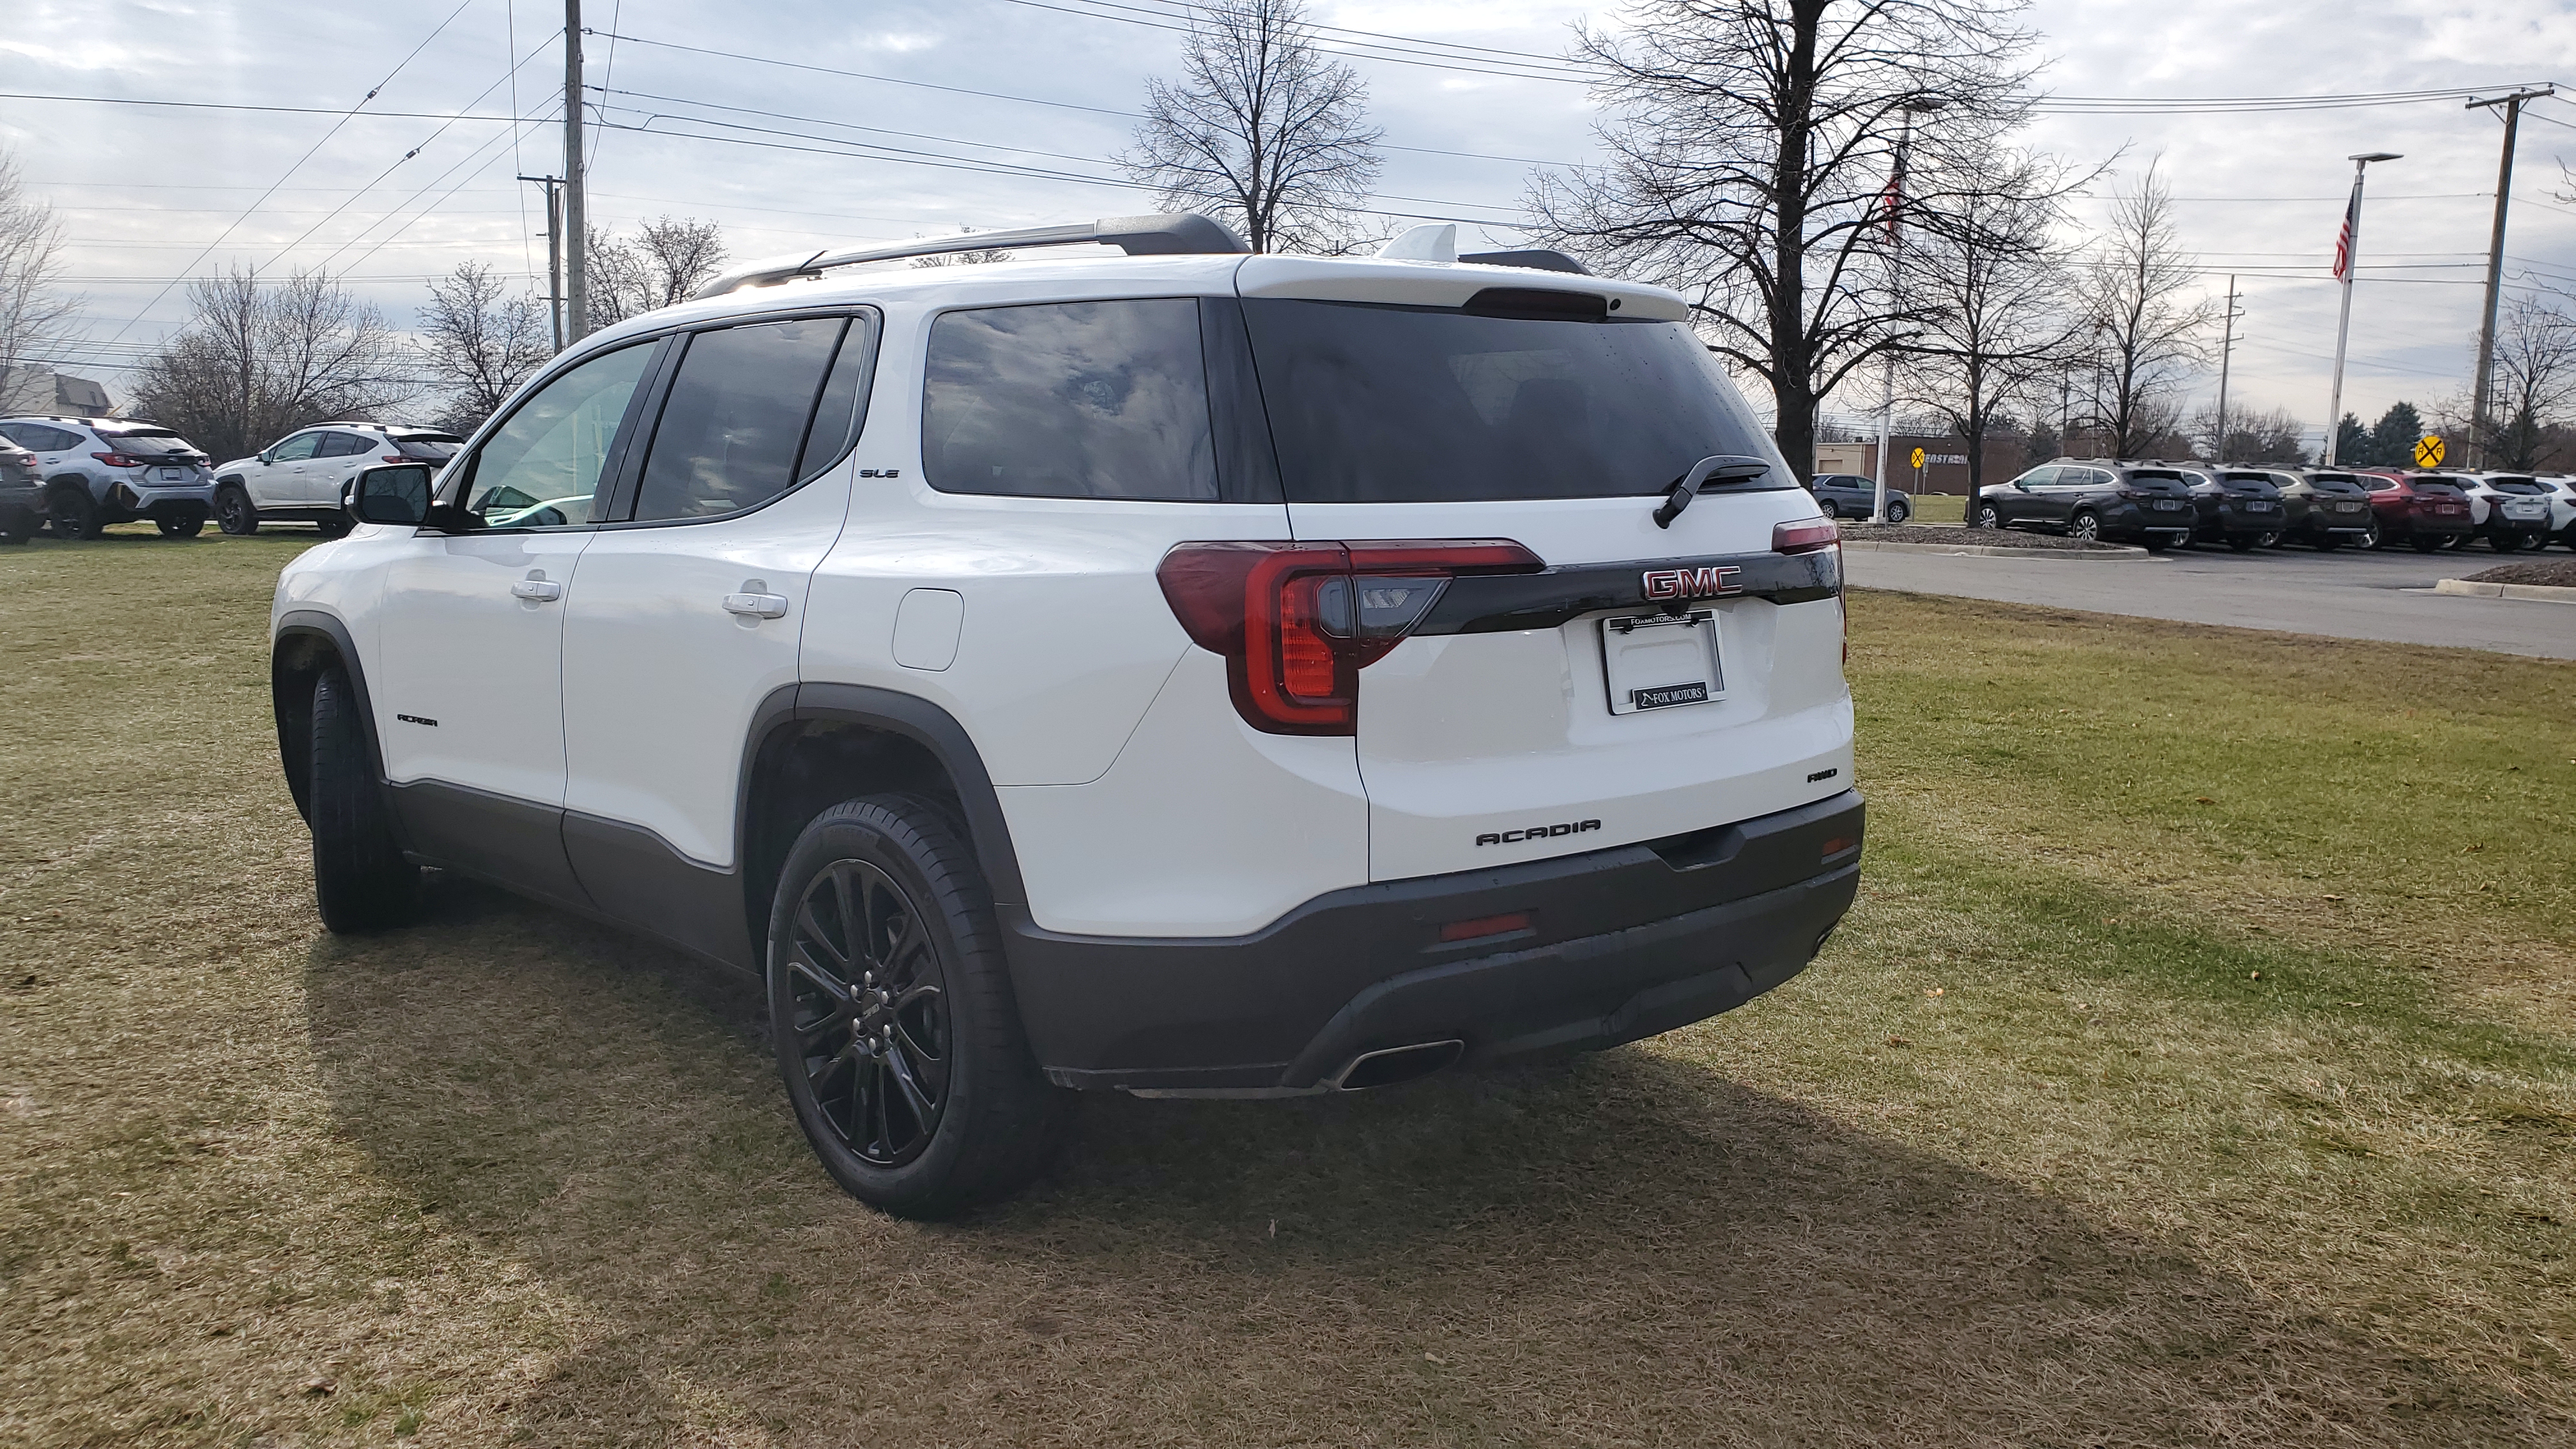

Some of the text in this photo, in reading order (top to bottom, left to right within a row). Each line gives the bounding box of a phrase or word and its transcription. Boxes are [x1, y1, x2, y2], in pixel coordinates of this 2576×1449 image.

[859, 468, 900, 479] SLE
[1643, 565, 1743, 601] GMC
[1653, 687, 1702, 704] FOX MOTORS
[1807, 768, 1837, 783] AWD
[1476, 818, 1601, 847] ACADIA
